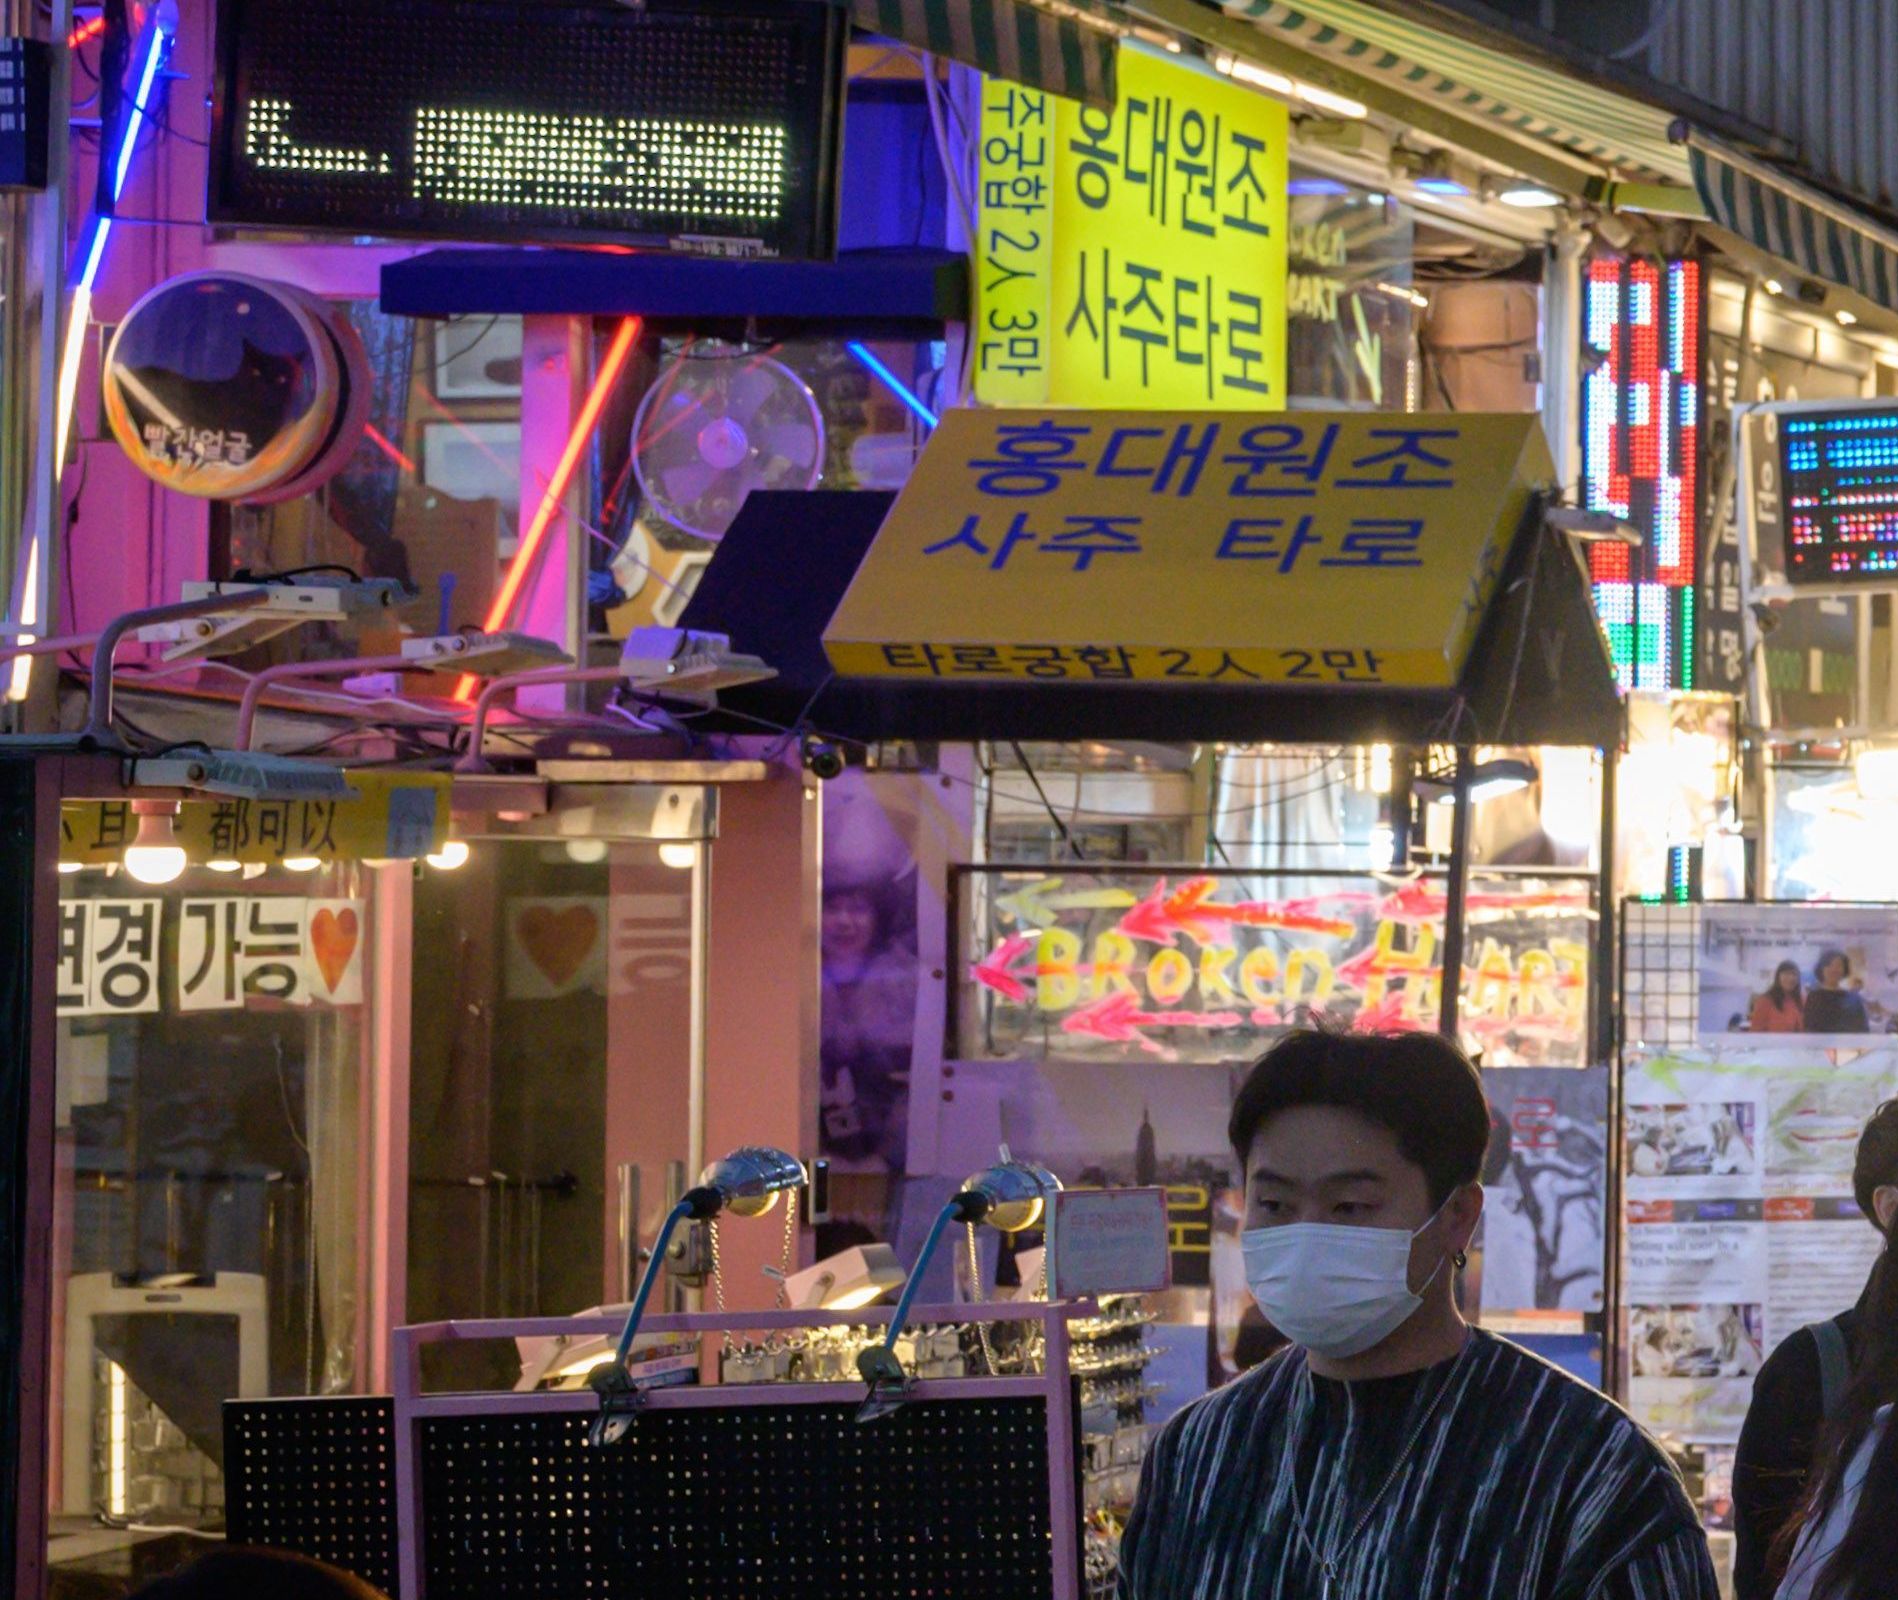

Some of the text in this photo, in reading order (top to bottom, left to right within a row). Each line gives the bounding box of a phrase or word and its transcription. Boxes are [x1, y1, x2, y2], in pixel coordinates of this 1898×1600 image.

[983, 75, 1047, 216] 주궁합
[1067, 96, 1271, 239] 홍대원조
[967, 419, 1461, 499] 홍대원조
[922, 511, 1426, 574] 사주 타로
[881, 642, 1136, 682] 타로궁합
[1279, 649, 1386, 685] 2만
[58, 900, 299, 1009] 변경 가능
